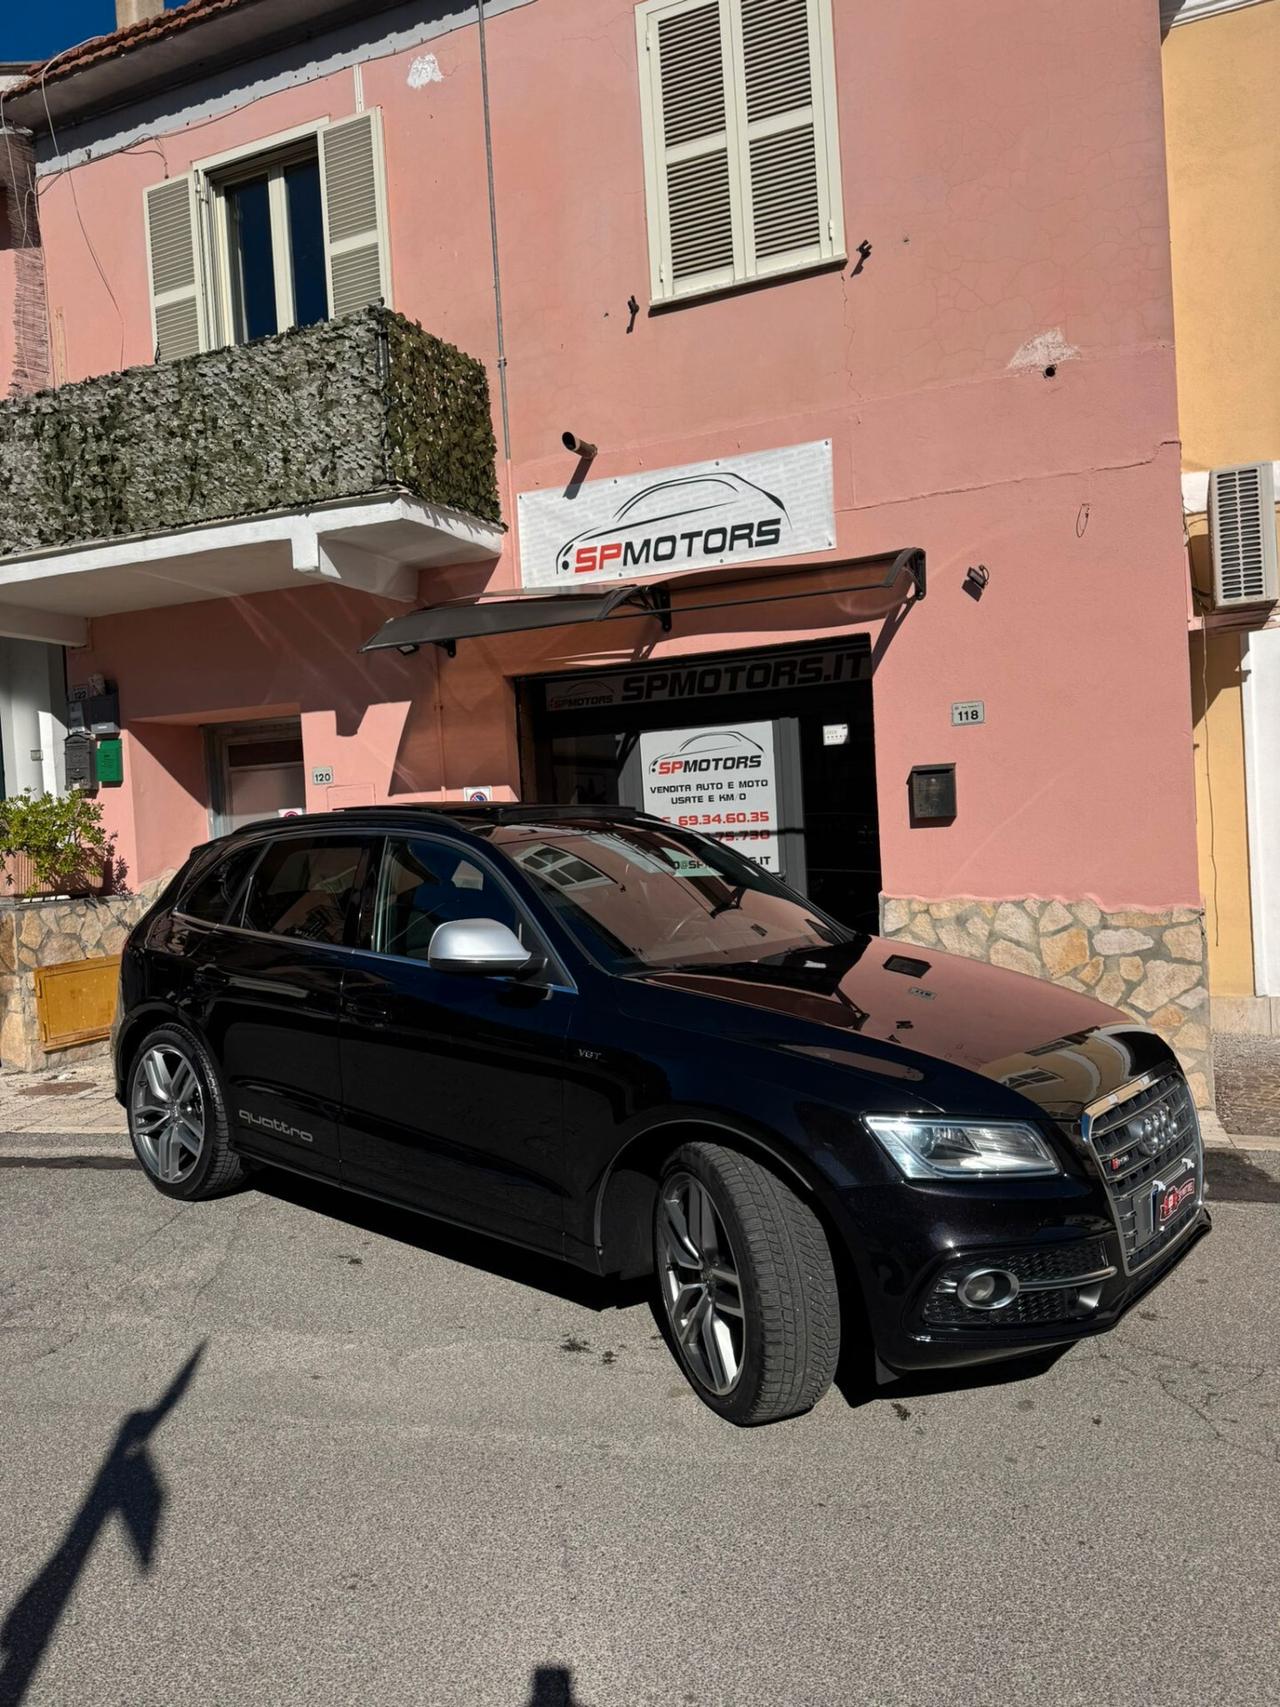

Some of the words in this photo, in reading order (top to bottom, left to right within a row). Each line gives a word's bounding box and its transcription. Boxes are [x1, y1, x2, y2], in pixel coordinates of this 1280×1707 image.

[575, 518, 781, 573] SPMOTORS
[621, 652, 865, 701] SPMOTORS.IT
[958, 710, 979, 721] 118
[658, 755, 762, 775] SPMOTORS
[315, 773, 331, 782] 120
[650, 784, 691, 794] VENDITA
[696, 782, 723, 791] AUTO
[728, 781, 734, 789] E
[738, 779, 768, 788] MOTO
[671, 795, 703, 804] USATE
[708, 794, 714, 802] E
[719, 793, 734, 802] KM
[239, 1109, 313, 1142] quattro
